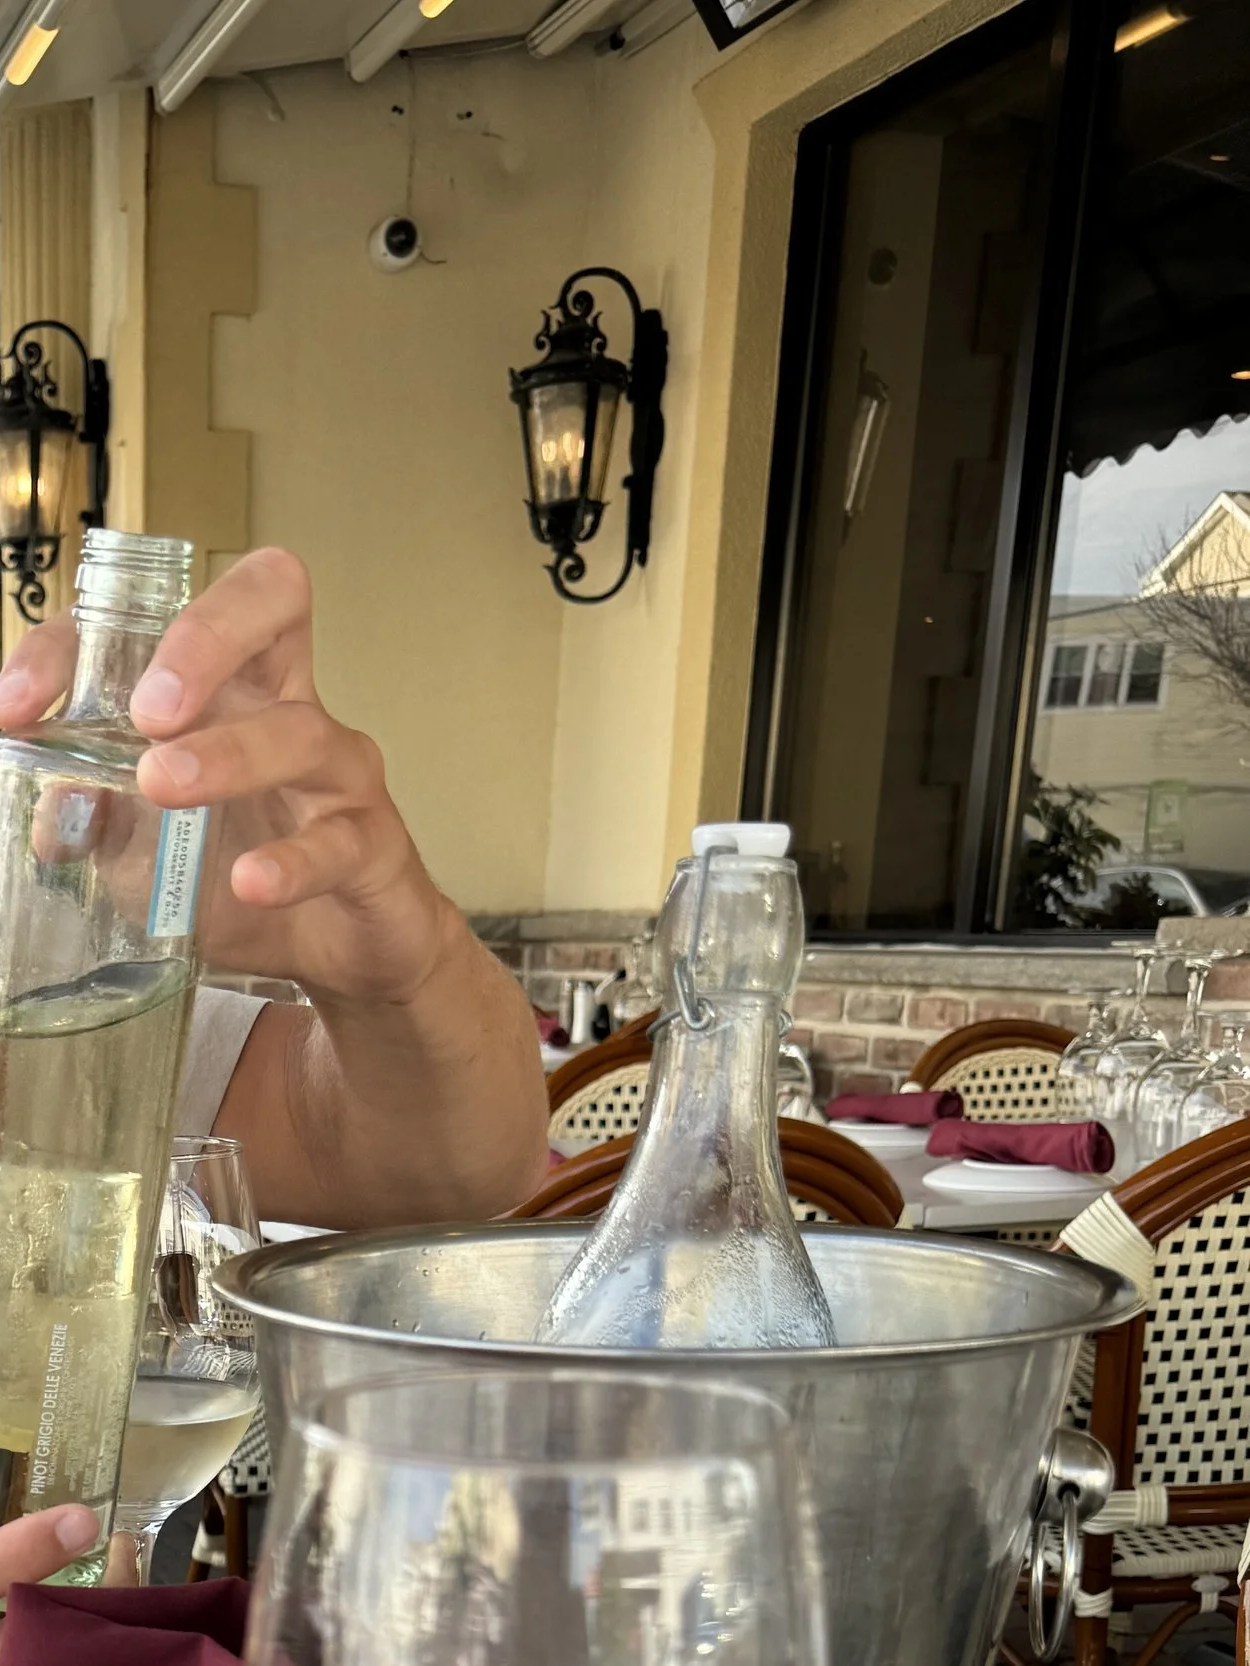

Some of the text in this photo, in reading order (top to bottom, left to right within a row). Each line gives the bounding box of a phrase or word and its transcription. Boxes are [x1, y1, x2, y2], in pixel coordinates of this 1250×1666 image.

[48, 1323, 67, 1374] VENEZIE
[42, 1374, 60, 1410] DELLE
[36, 1411, 55, 1457] GRIGIO
[30, 1460, 48, 1495] PINOT
